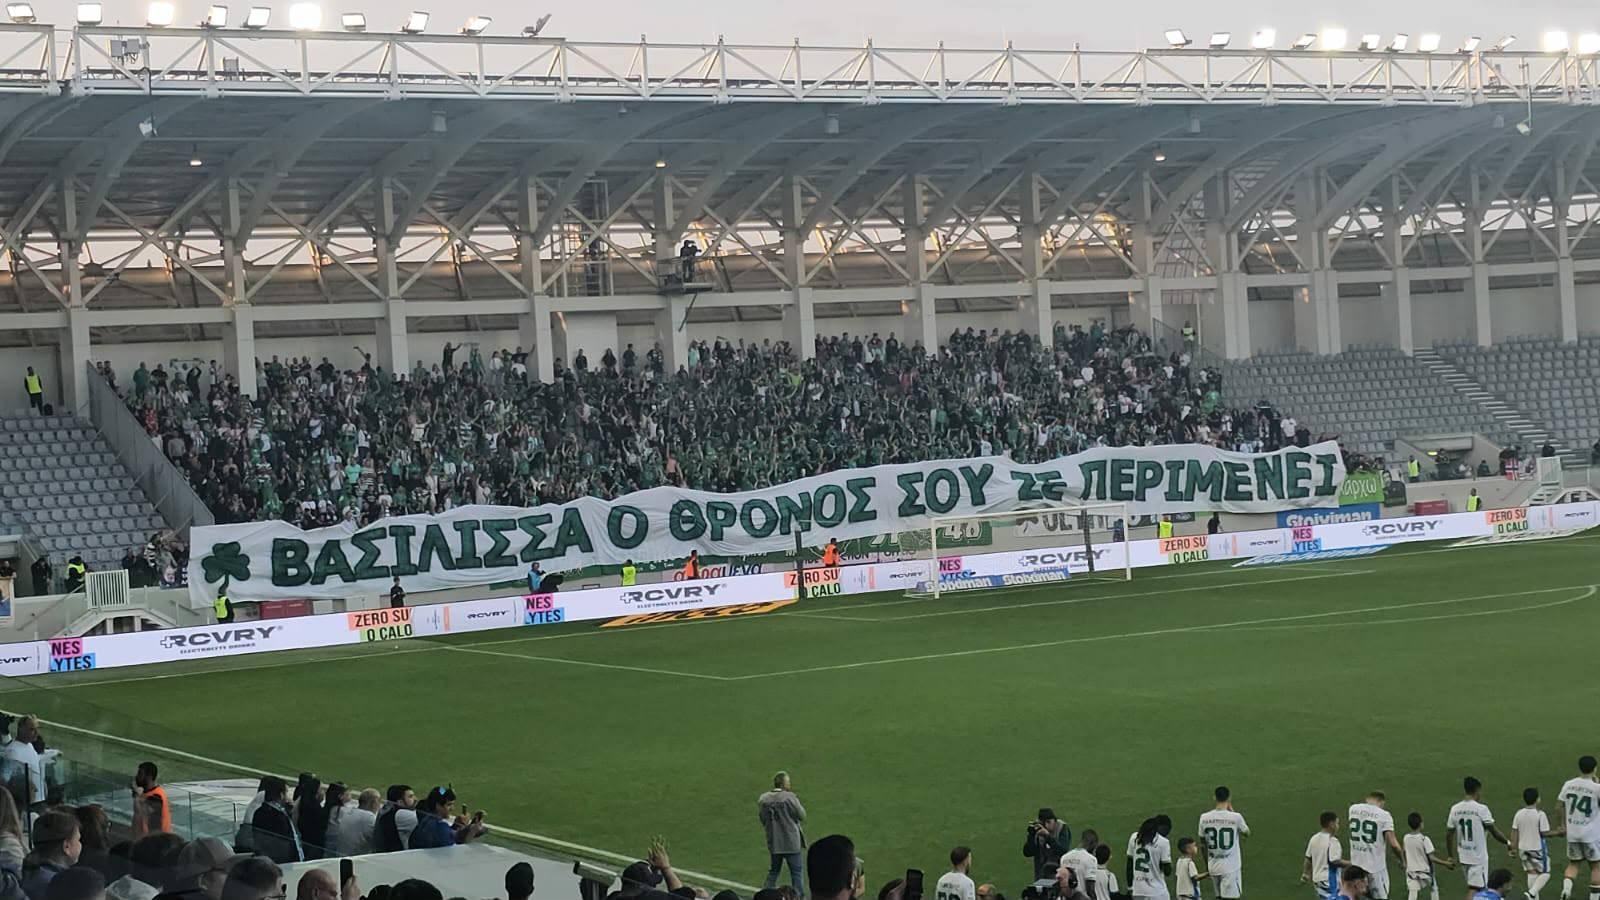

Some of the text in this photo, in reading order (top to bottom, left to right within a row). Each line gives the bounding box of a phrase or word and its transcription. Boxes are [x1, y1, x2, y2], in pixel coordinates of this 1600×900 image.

[272, 507, 594, 586] ΒΑΣΙΛΙΣΣΑ
[607, 505, 649, 549] Ο
[669, 477, 877, 541] ΘΡΟΝΟΣ
[897, 463, 994, 517] ΣΟΥ
[1078, 451, 1338, 502] ΠΕΡΙΜΕΝΕΙ
[1165, 536, 1208, 551] ZERO SU
[790, 570, 820, 586] ZRO
[823, 568, 841, 581] SU
[355, 608, 412, 627] ZERO SU
[379, 623, 413, 640] CALO
[1566, 793, 1592, 818] 74
[1204, 827, 1234, 850] 30
[1349, 818, 1378, 844] 29
[1459, 818, 1473, 841] 11
